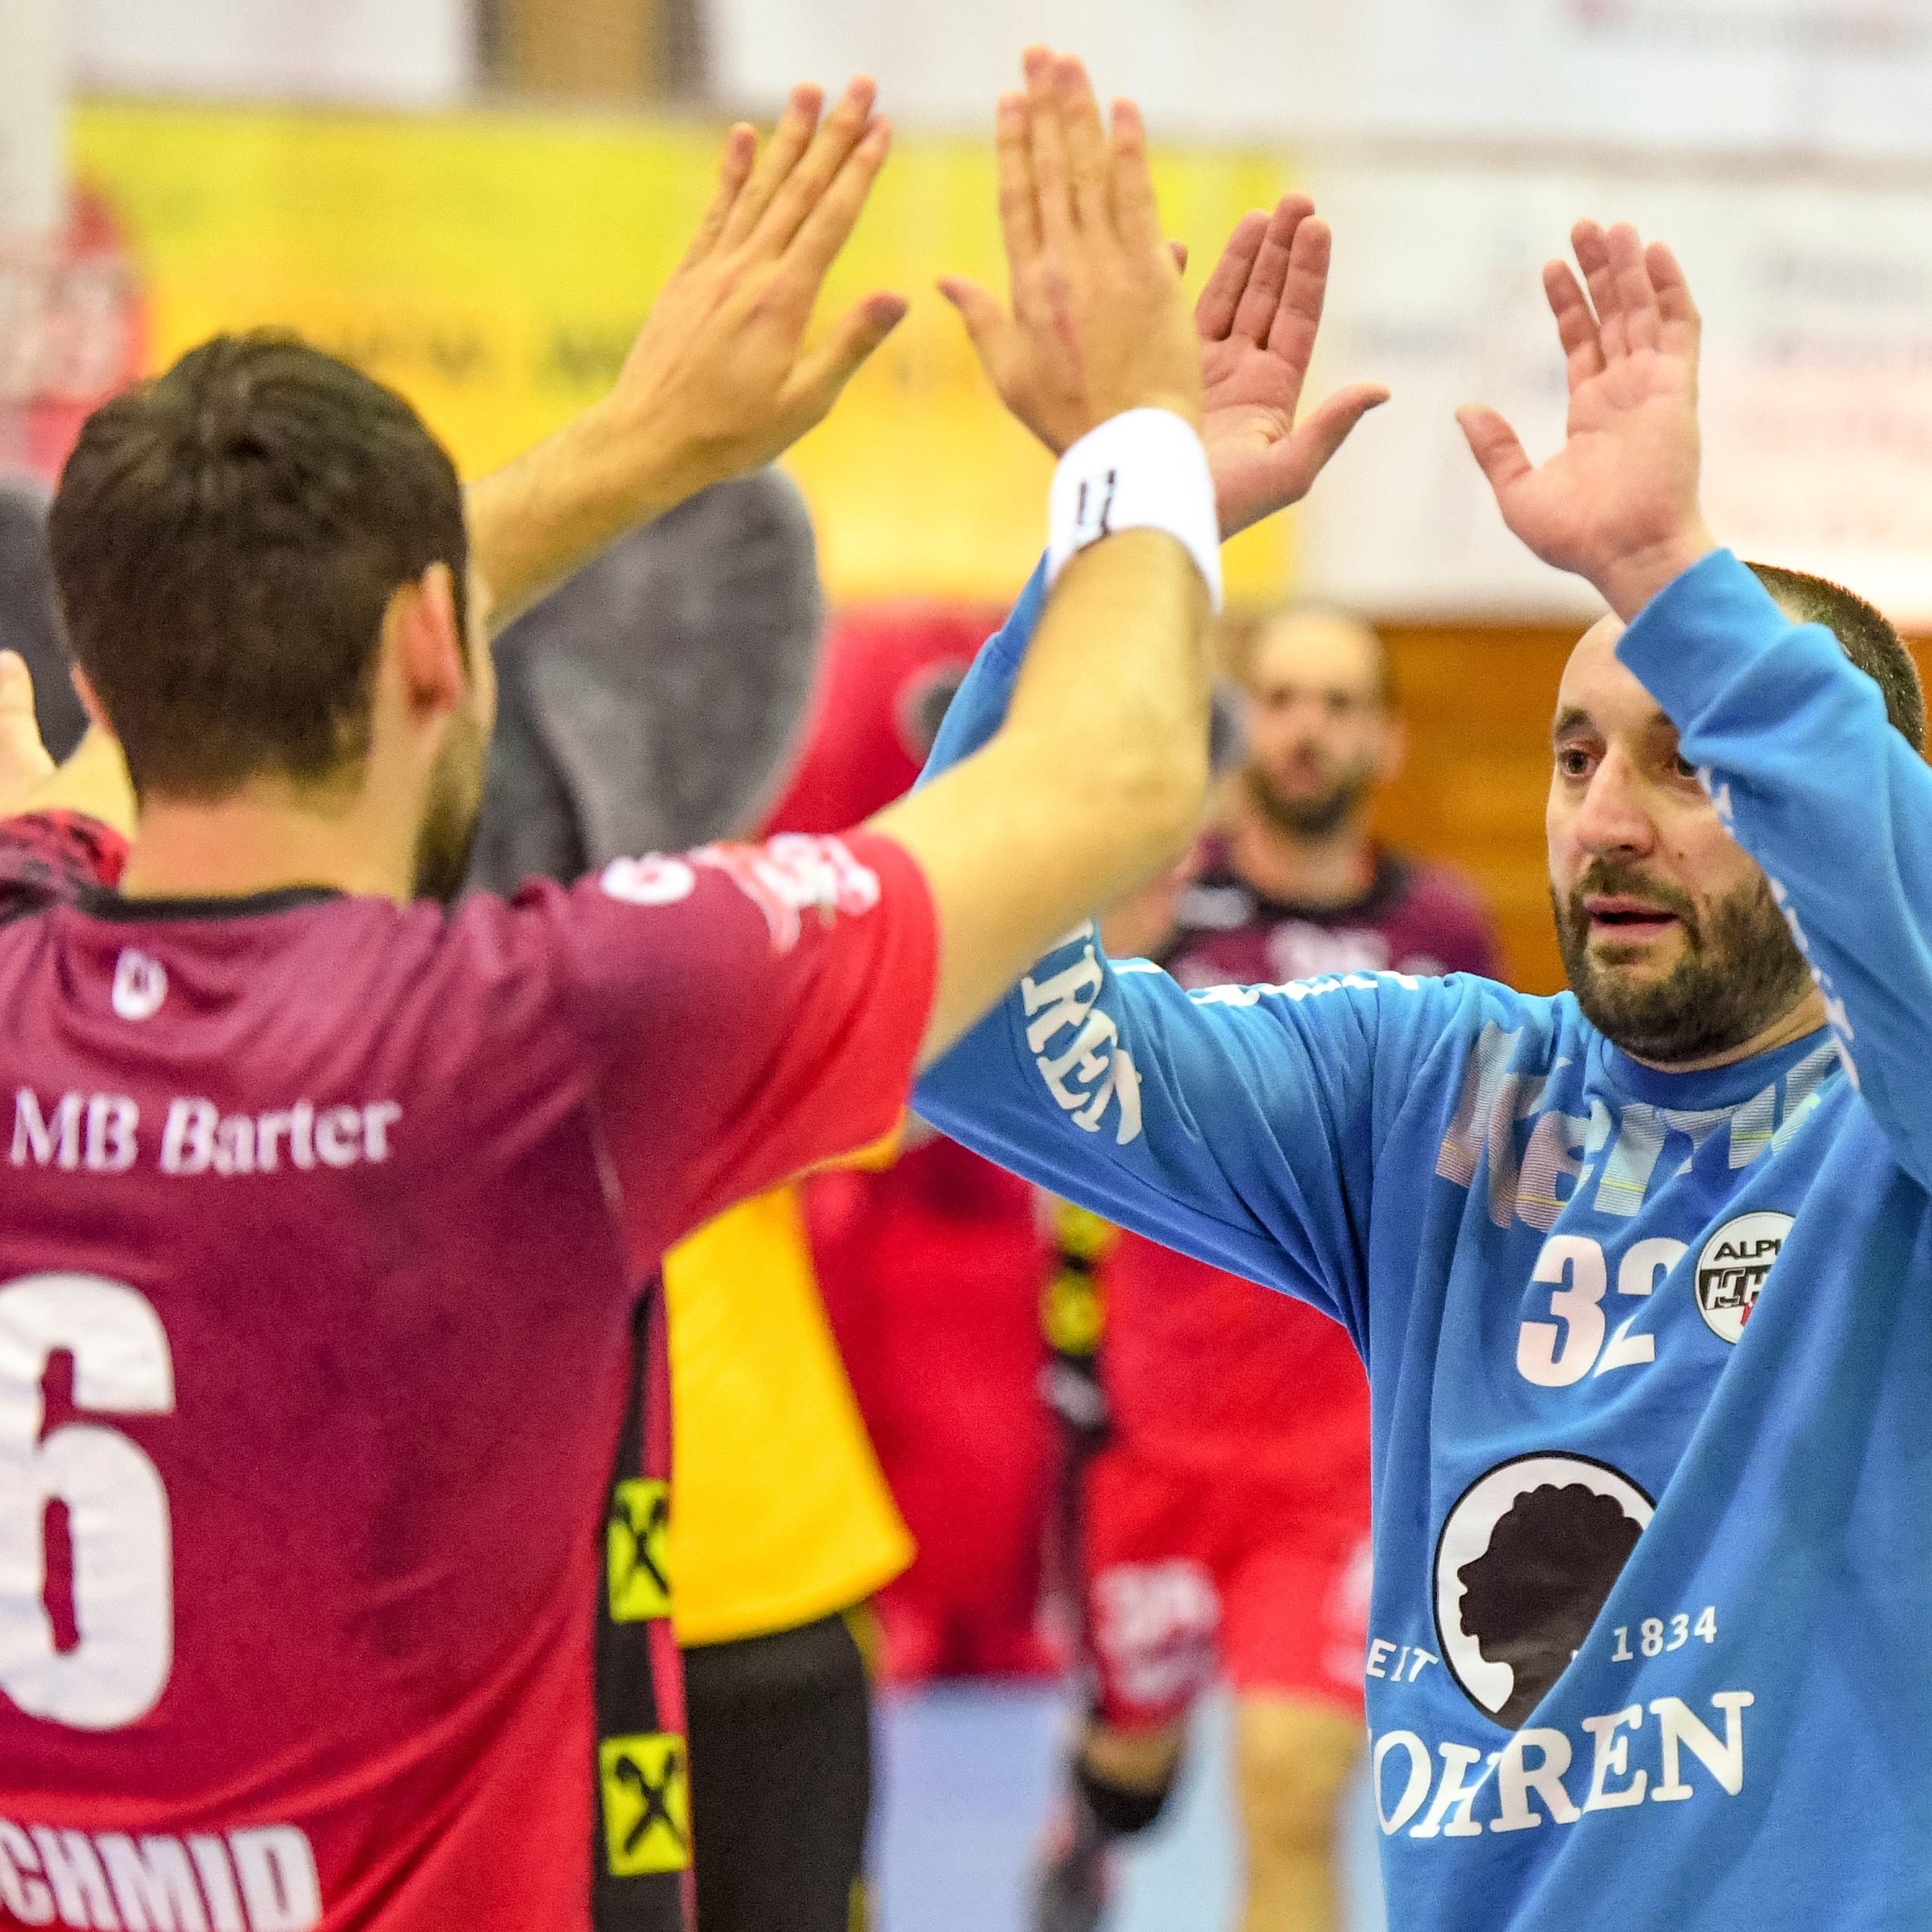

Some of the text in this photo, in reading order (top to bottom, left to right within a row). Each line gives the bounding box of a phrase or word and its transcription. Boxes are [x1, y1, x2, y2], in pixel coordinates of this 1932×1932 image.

[10, 1088, 403, 1175] MB Barter
[1515, 1235, 1690, 1387] 32
[0, 1271, 174, 1732] 6
[1366, 1606, 1717, 1682] EIT 1834
[1374, 1691, 1755, 1838] OHREN
[0, 1817, 322, 1932] CHMID
